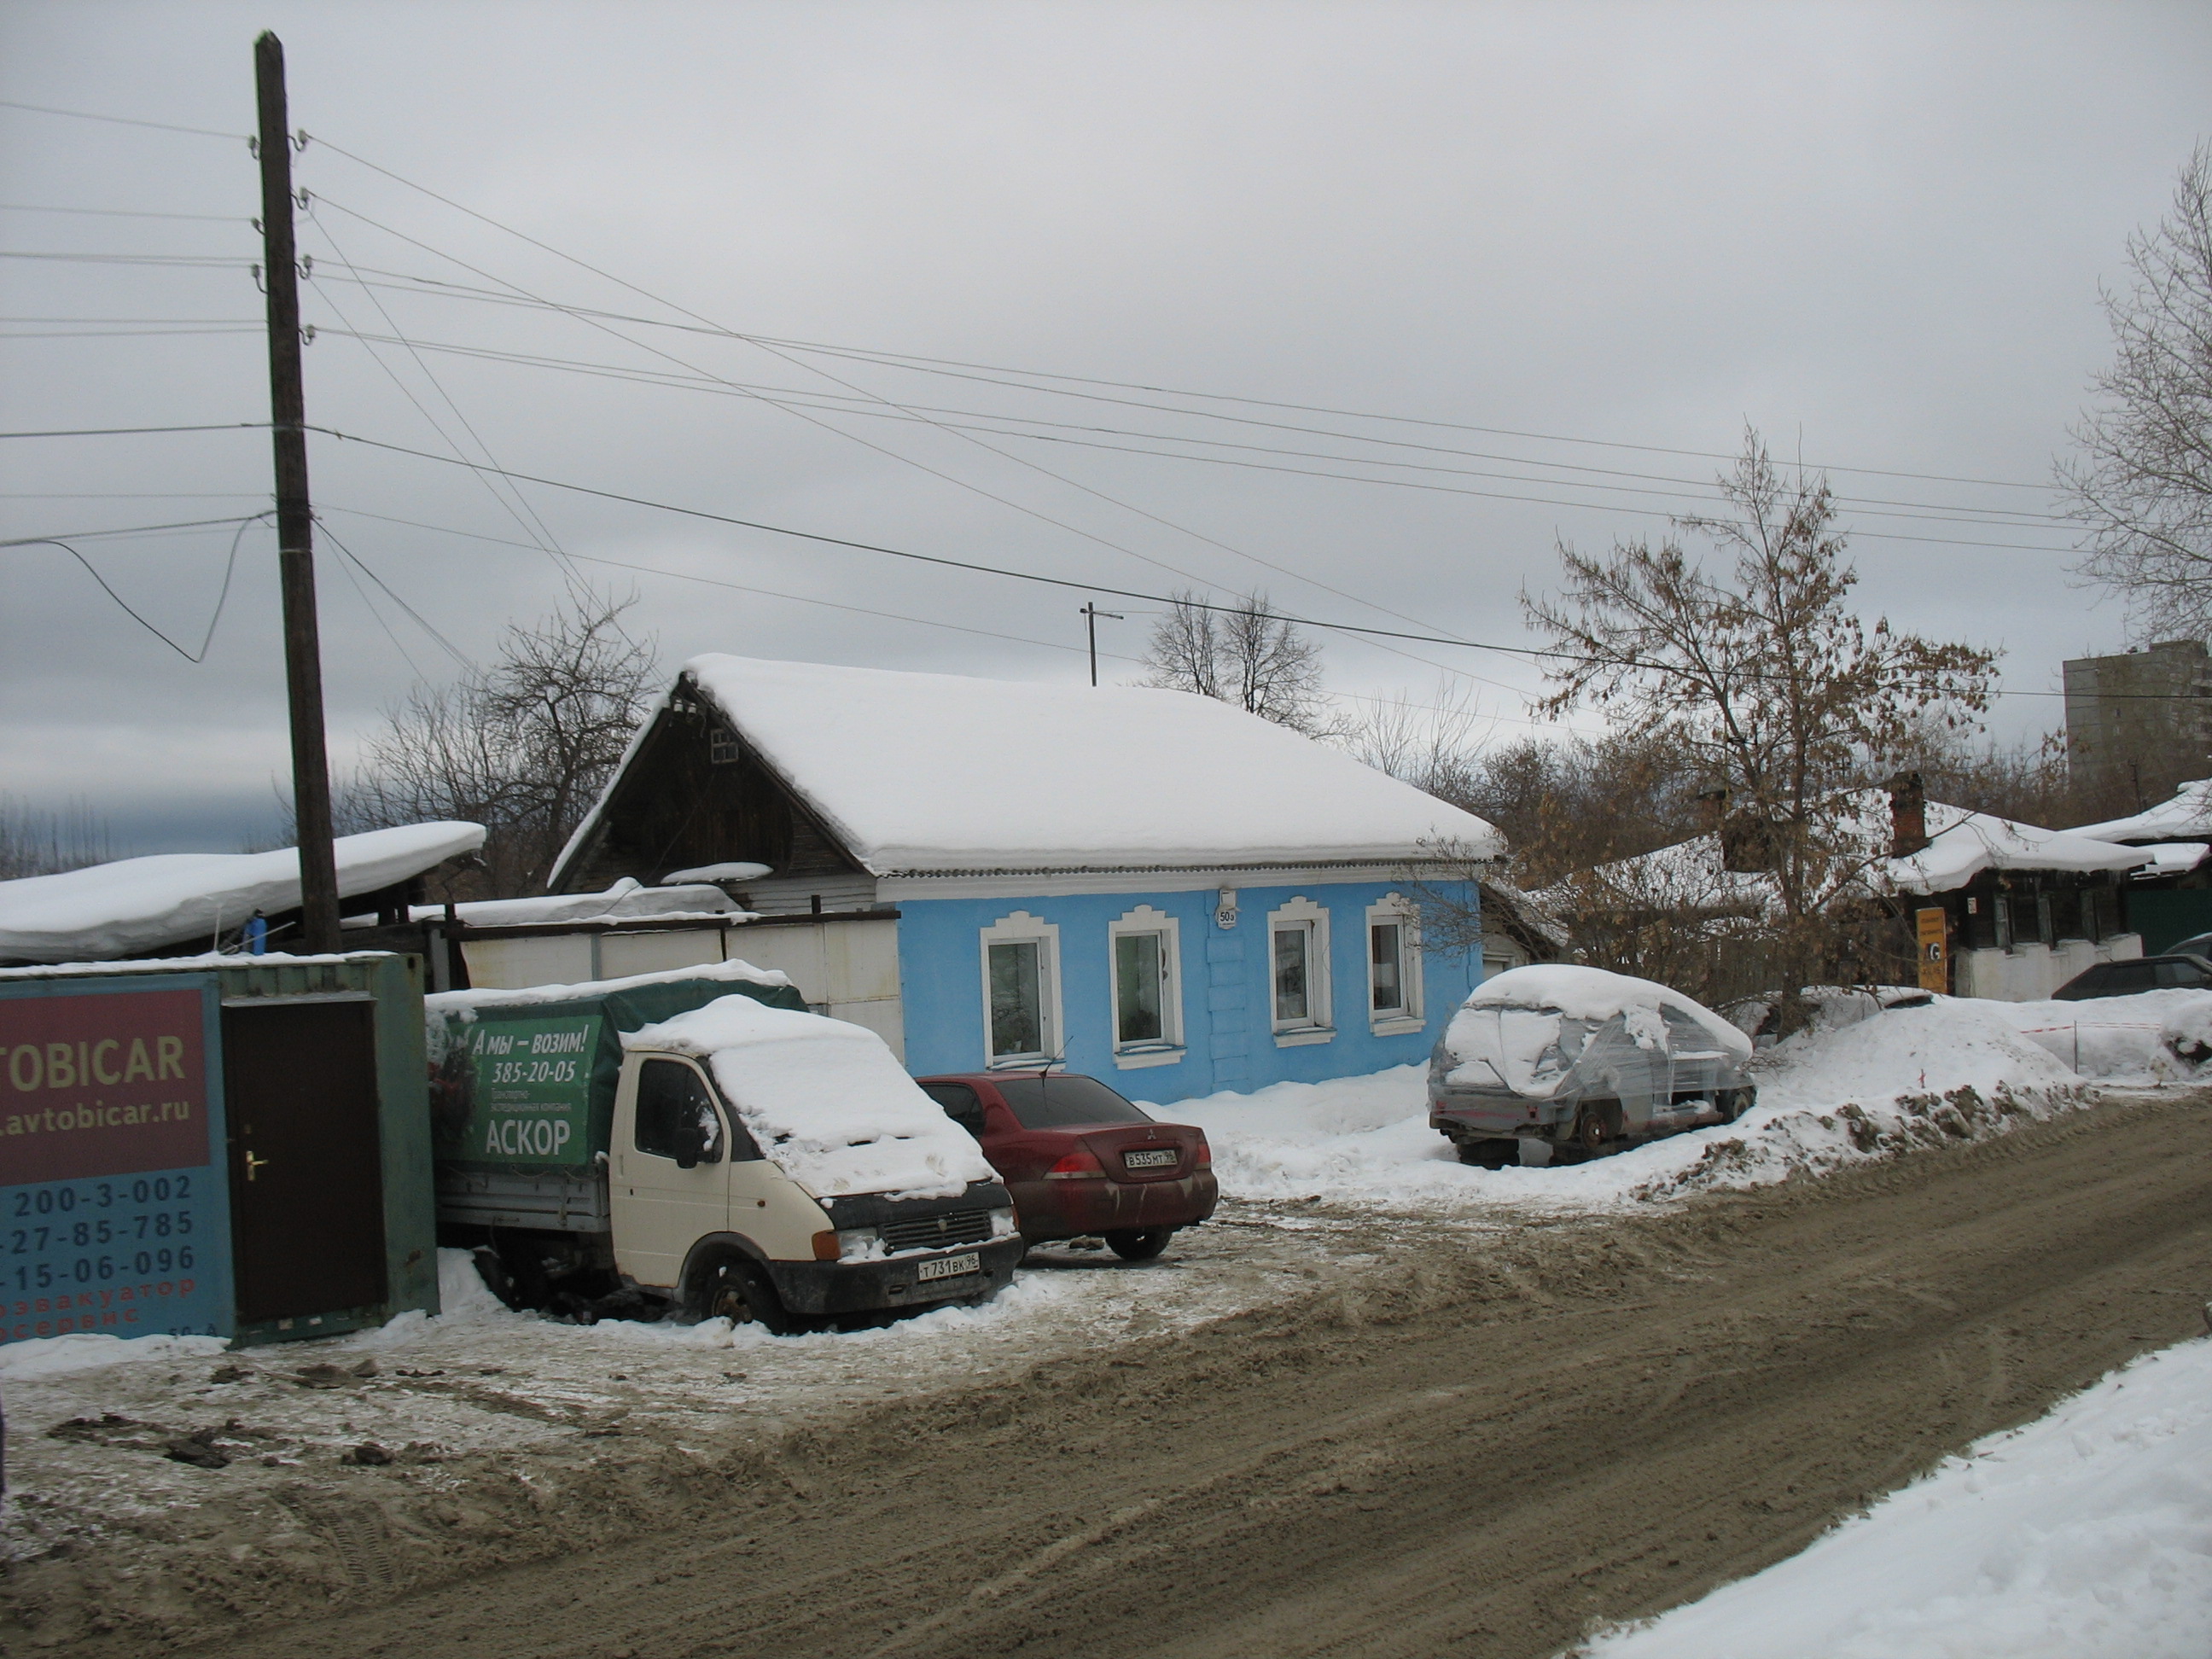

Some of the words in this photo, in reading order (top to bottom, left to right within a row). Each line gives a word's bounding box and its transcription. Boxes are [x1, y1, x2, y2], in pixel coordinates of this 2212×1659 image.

[472, 1029, 486, 1055] А
[486, 1035, 514, 1055] мы
[532, 1024, 589, 1054] возим!
[492, 1060, 576, 1083] 385-20-05
[486, 1119, 571, 1155] АСКОР
[15, 1175, 190, 1217] 200-3-002
